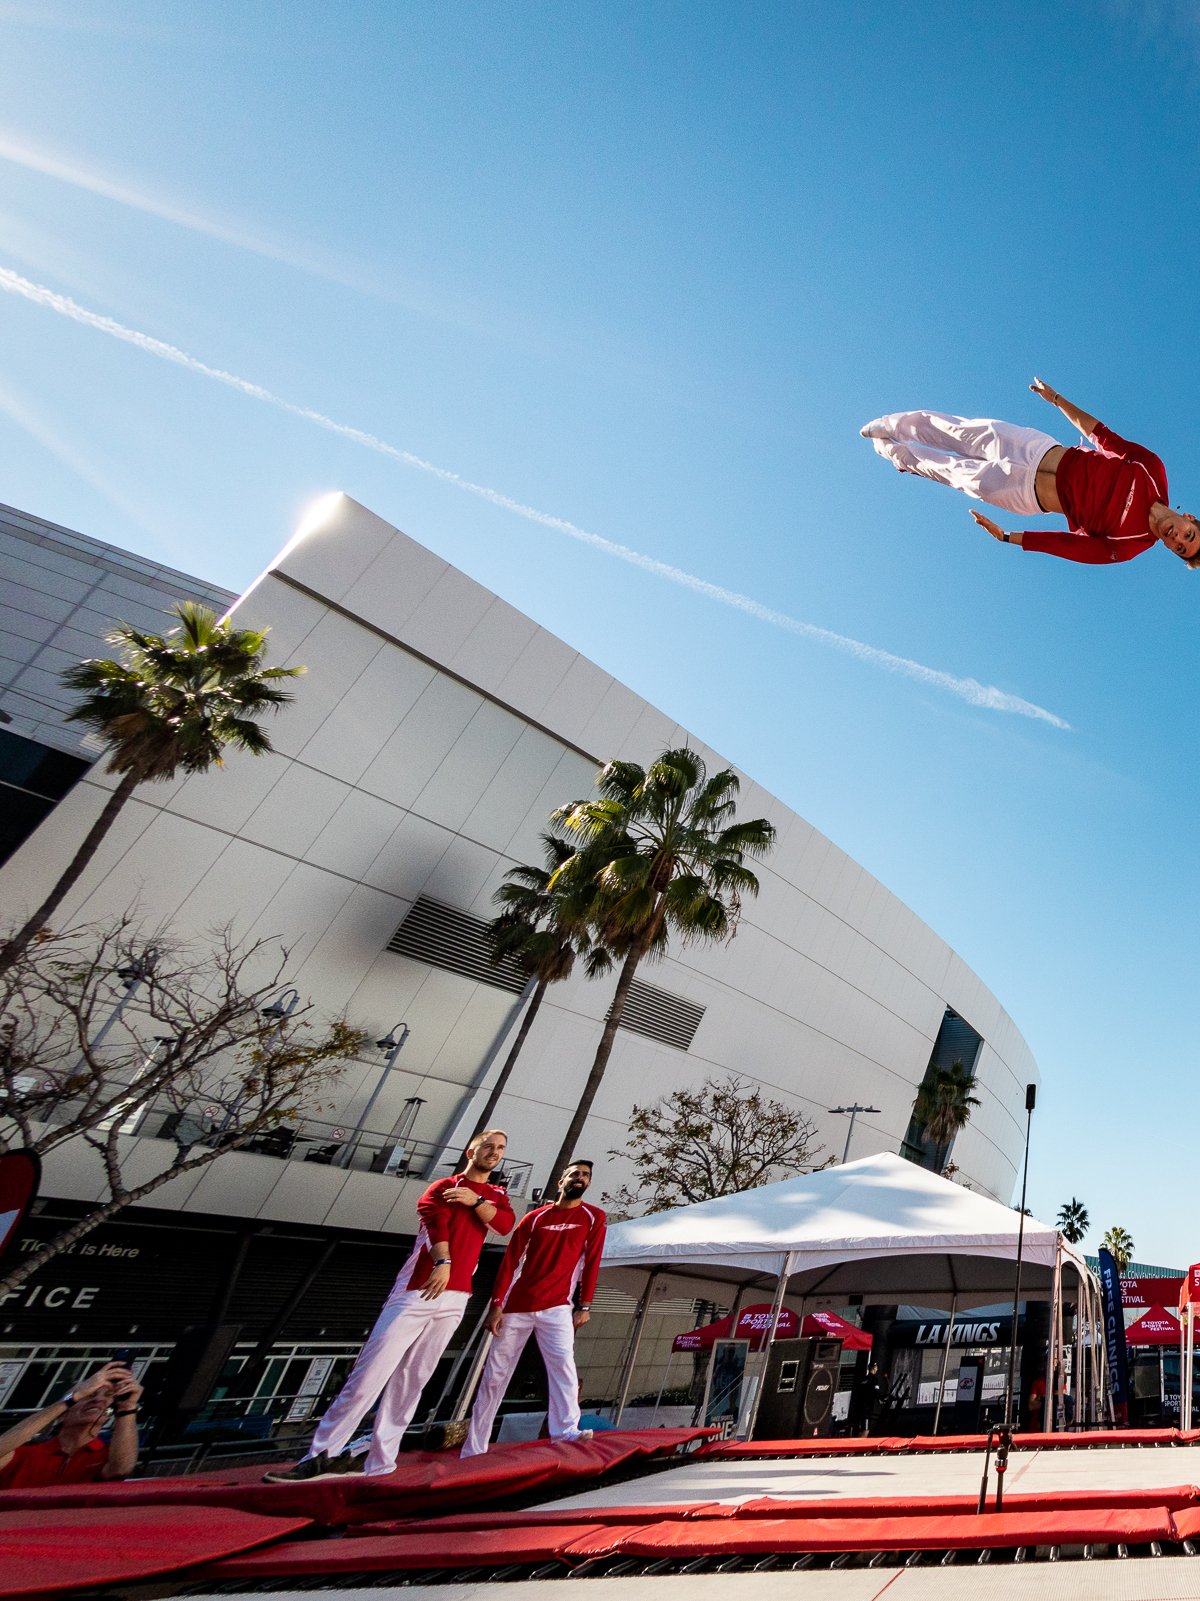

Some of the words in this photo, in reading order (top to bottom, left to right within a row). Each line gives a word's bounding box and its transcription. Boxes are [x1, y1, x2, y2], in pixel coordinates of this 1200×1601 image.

[98, 1244, 140, 1258] Here
[915, 1325, 942, 1344] LA
[942, 1323, 1000, 1343] KINGS
[1108, 1317, 1120, 1393] CLINICS
